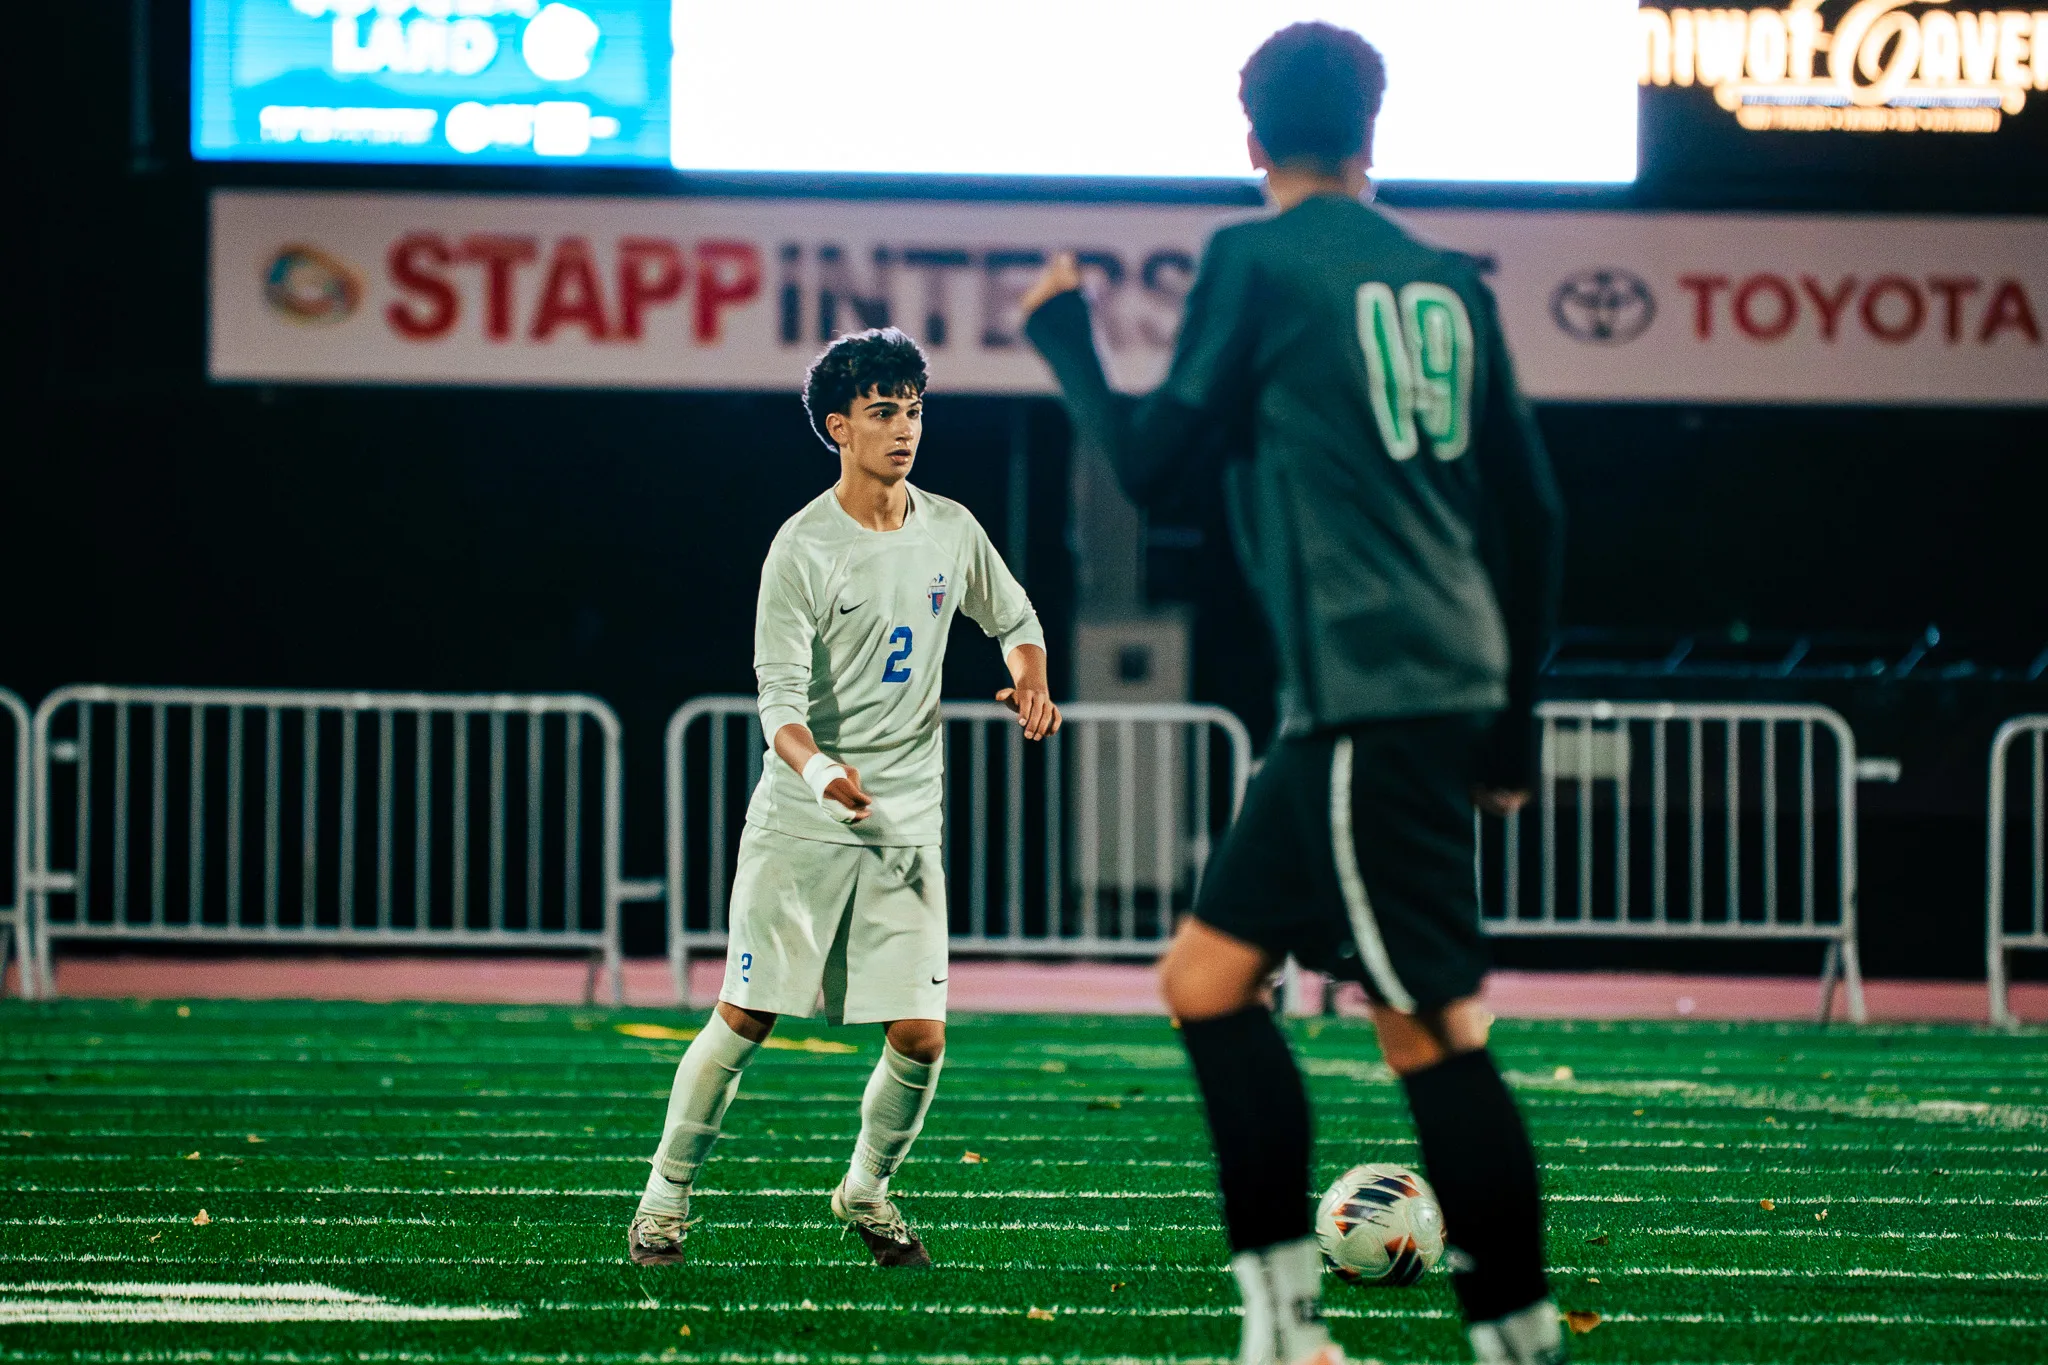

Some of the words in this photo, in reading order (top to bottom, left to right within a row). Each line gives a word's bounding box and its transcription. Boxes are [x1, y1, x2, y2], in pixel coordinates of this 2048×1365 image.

[386, 228, 762, 346] STAPP
[1679, 271, 2042, 346] TOYOTA
[1356, 281, 1474, 461] 19
[881, 626, 913, 683] 2
[741, 953, 753, 983] 2
